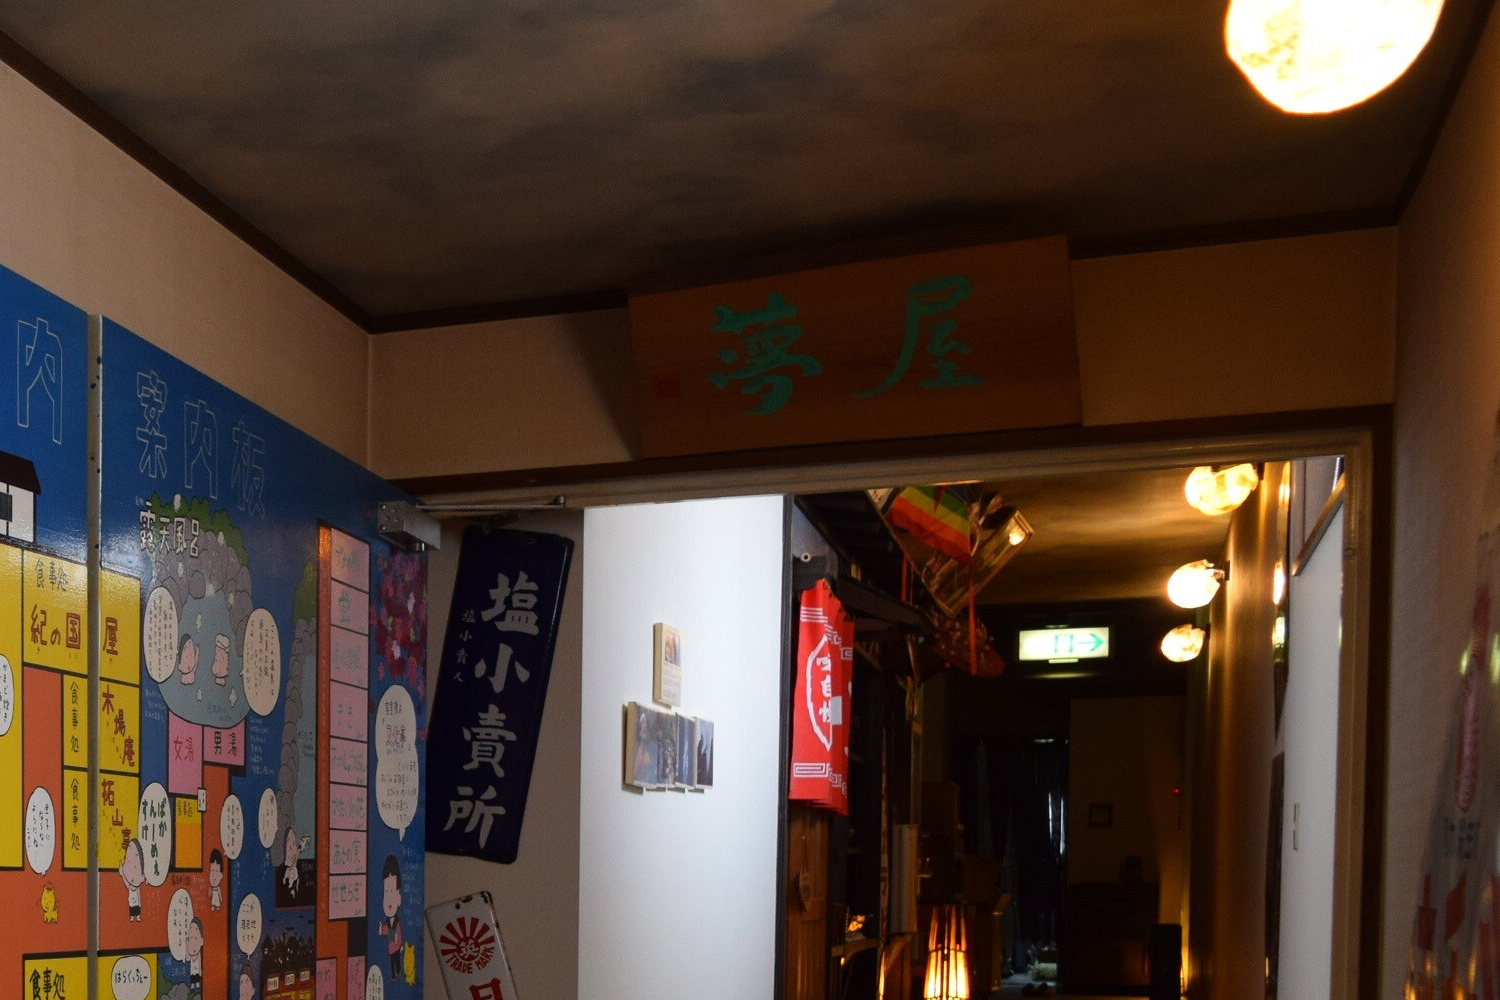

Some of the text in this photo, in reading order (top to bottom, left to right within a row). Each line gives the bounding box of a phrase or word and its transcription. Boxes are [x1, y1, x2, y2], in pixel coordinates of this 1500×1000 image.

[707, 275, 984, 415] 夢屋
[136, 371, 266, 520] 案内板
[140, 510, 199, 559] 露天風呂
[34, 559, 69, 592] 食事処
[69, 681, 80, 753] 食事処
[70, 778, 80, 851] 食事処
[446, 945, 496, 974] TRADE MARK
